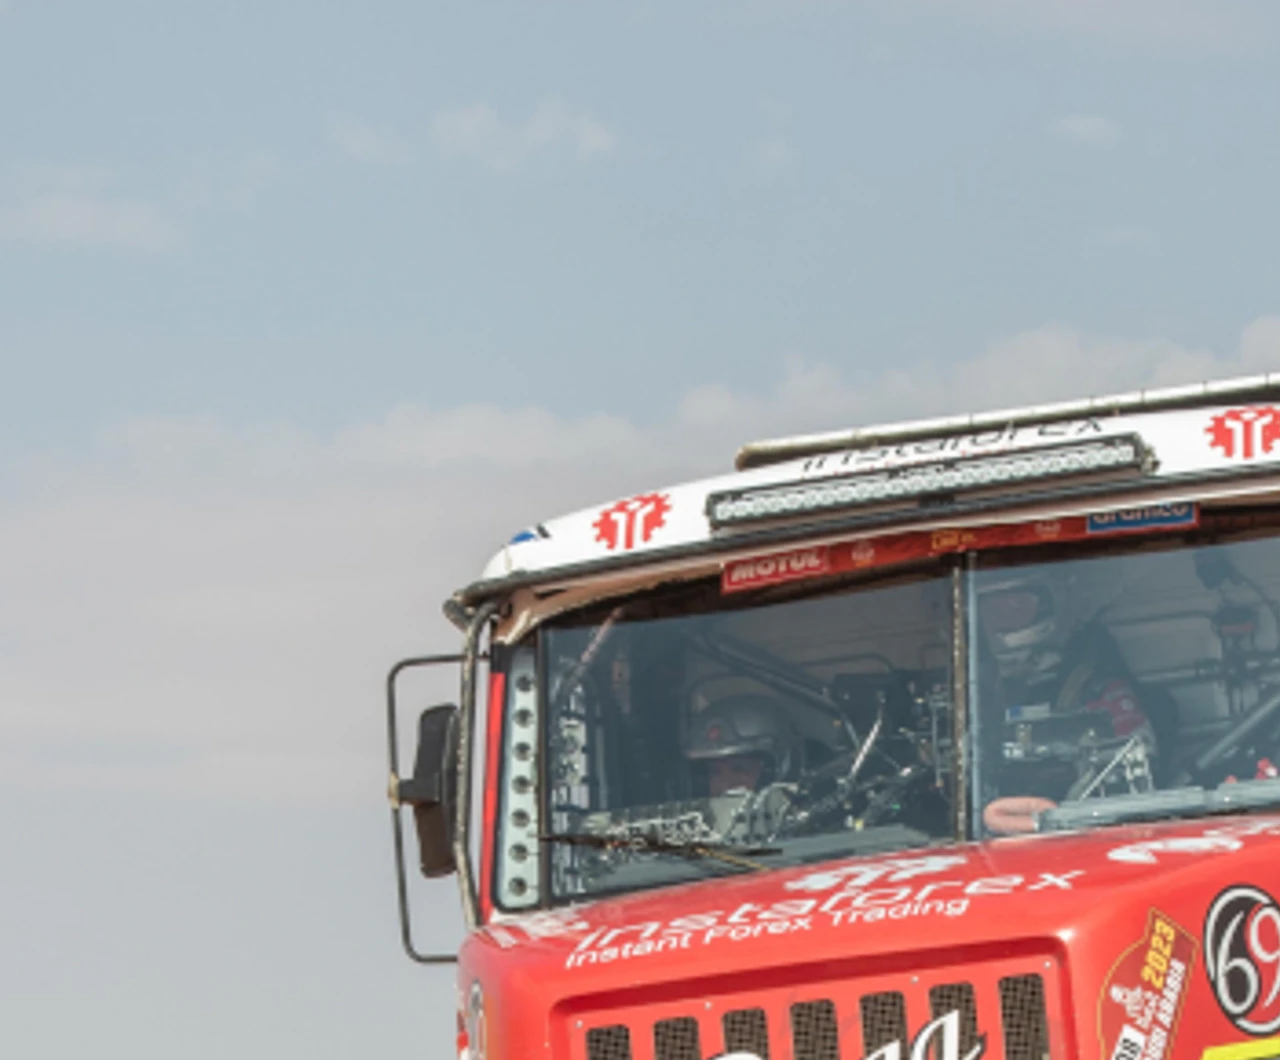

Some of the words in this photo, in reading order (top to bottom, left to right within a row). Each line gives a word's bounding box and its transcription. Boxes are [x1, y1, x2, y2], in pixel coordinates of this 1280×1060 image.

[729, 552, 823, 582] MOTUL
[576, 868, 1086, 950] instaforex
[704, 915, 813, 947] Forex
[830, 897, 971, 930] Trading
[1141, 918, 1177, 989] 2023
